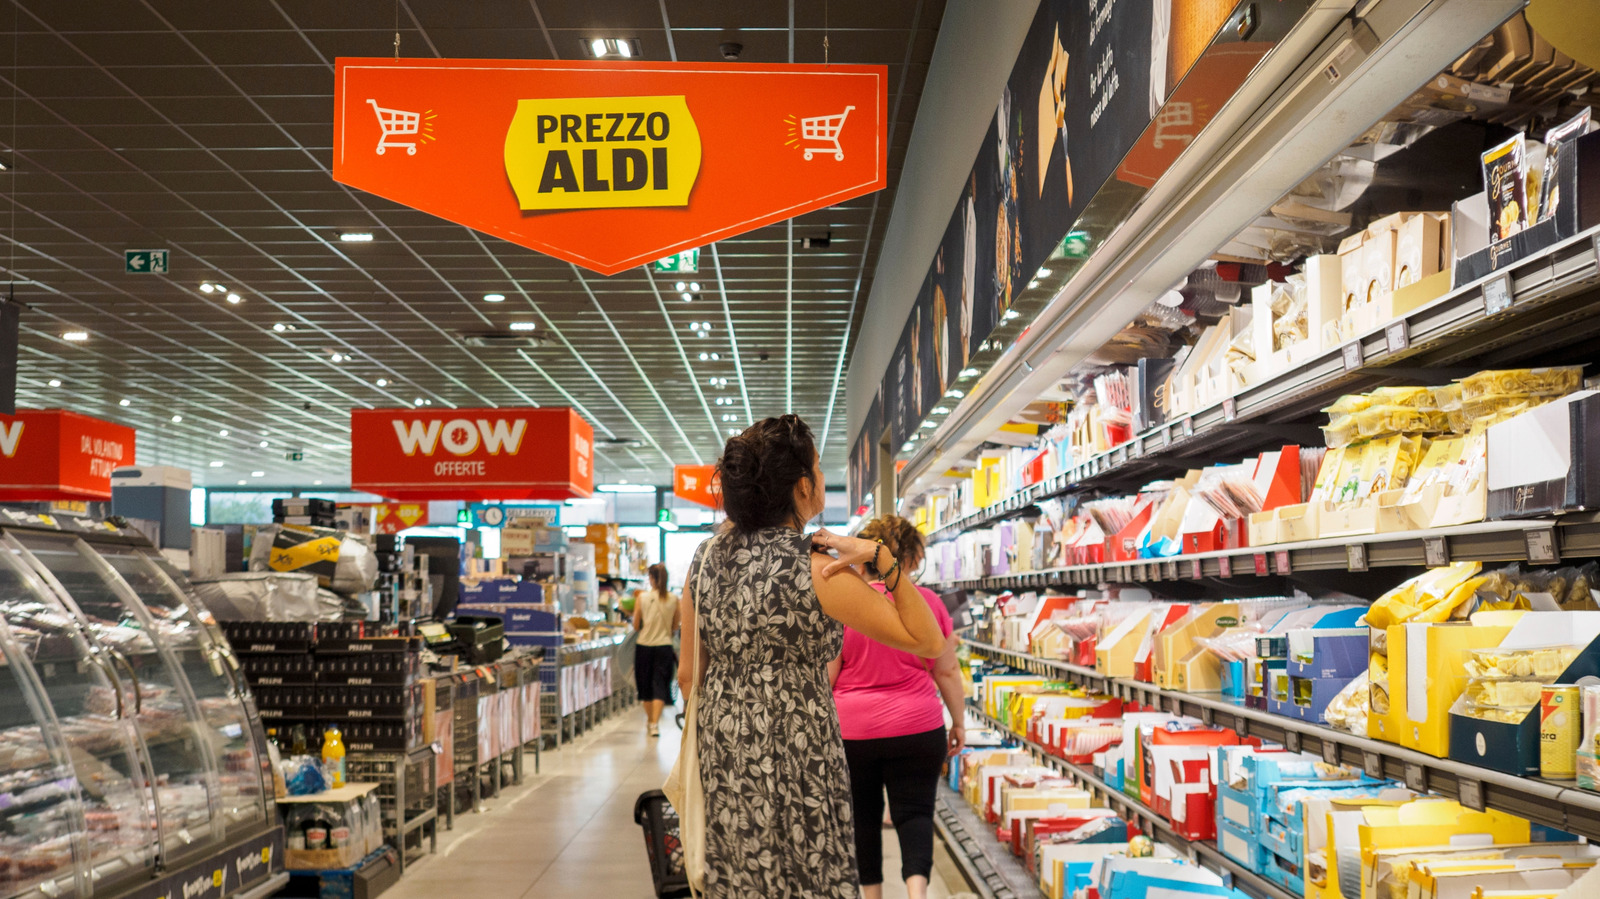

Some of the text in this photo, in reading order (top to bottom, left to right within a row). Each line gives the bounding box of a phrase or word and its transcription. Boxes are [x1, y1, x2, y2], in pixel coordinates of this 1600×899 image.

[537, 112, 670, 144] PREZZO
[537, 147, 669, 193] ALDI
[392, 419, 527, 456] WOW
[434, 461, 486, 476] OFFERTE
